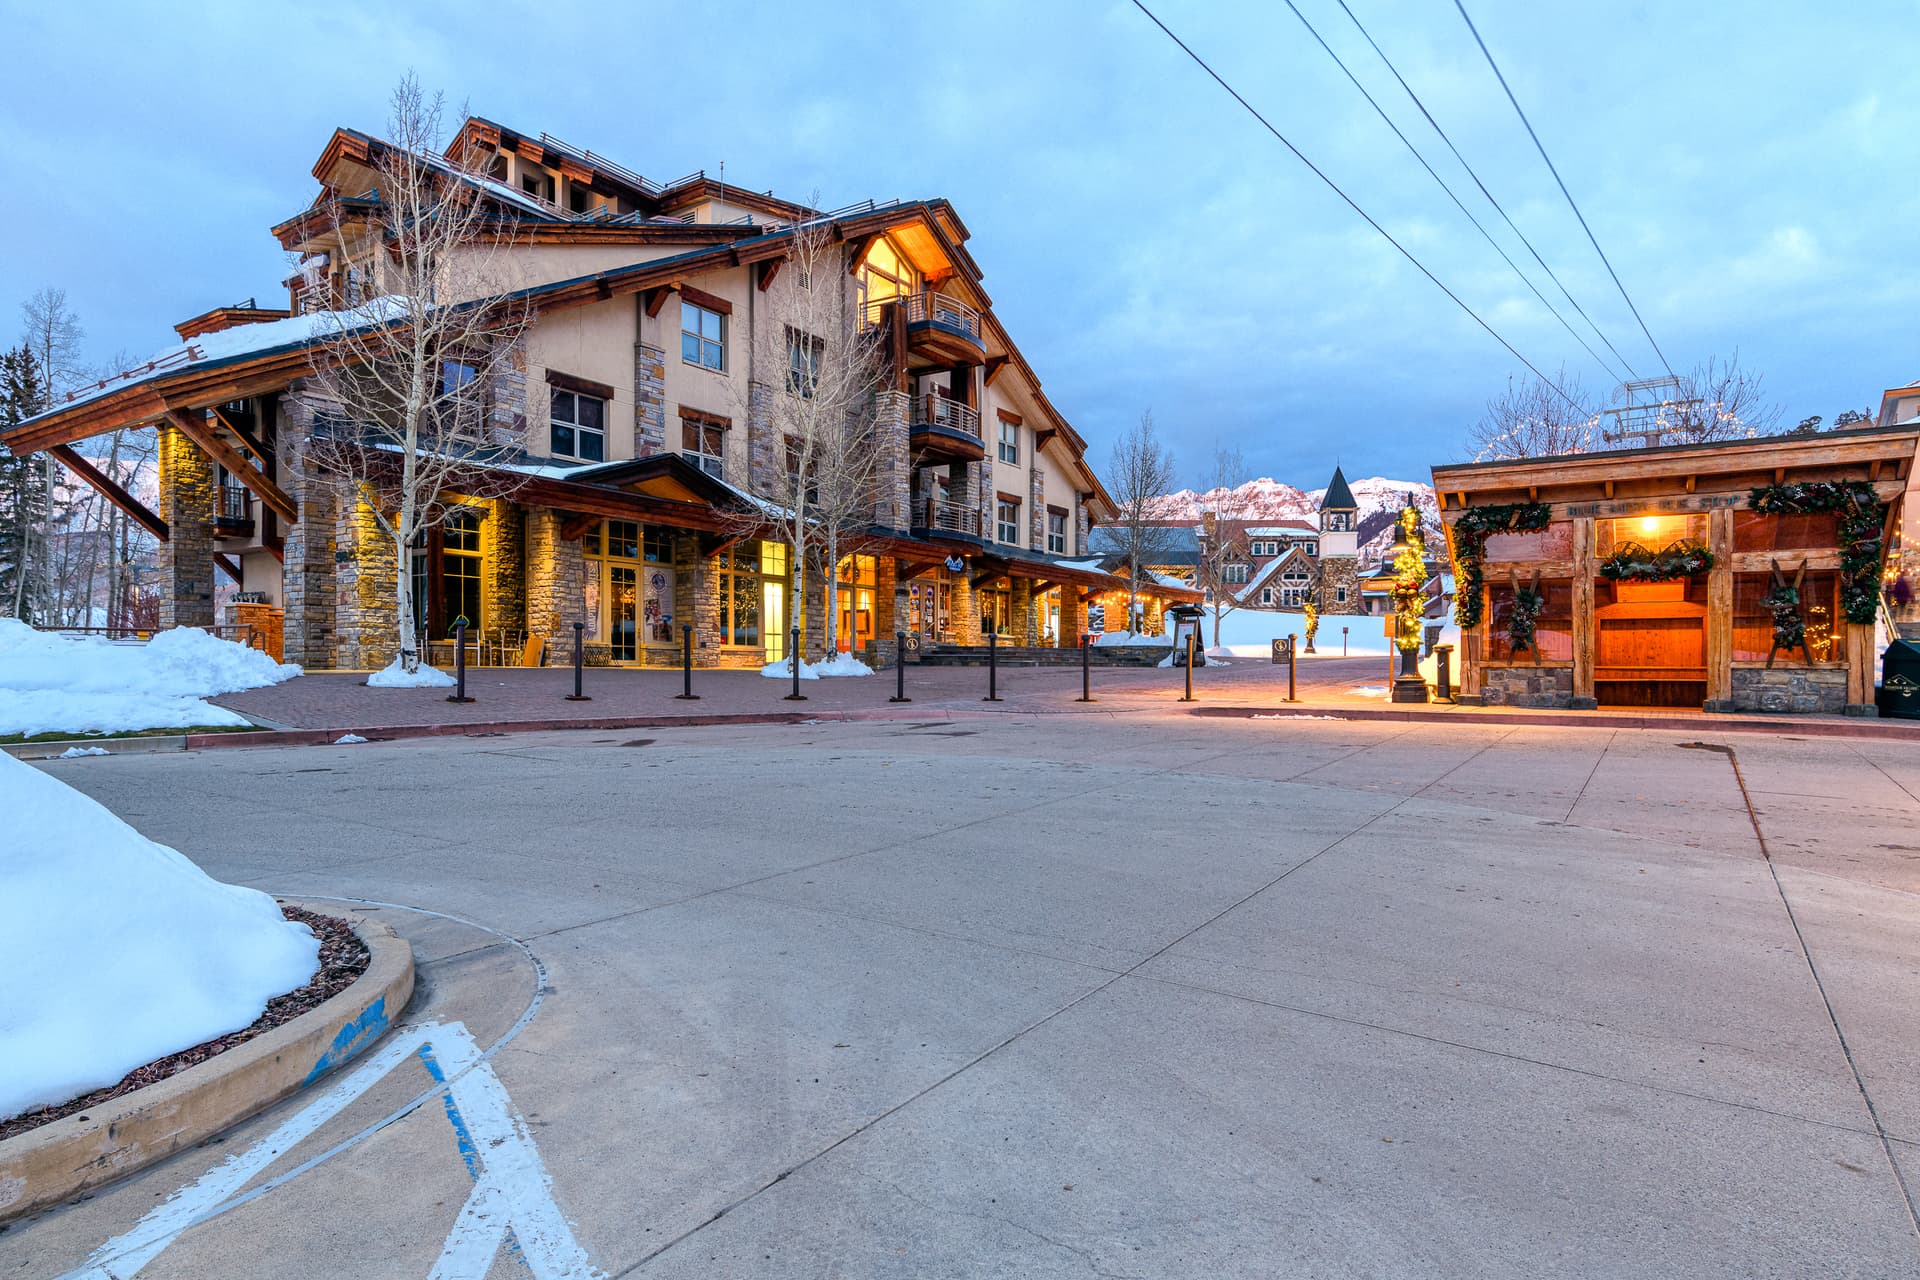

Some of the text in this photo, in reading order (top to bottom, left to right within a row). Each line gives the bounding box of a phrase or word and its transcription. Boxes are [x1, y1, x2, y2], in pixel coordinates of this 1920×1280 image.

[1567, 504, 1600, 517] BLUE
[1659, 498, 1690, 511] BUS
[1700, 494, 1741, 508] STOP
